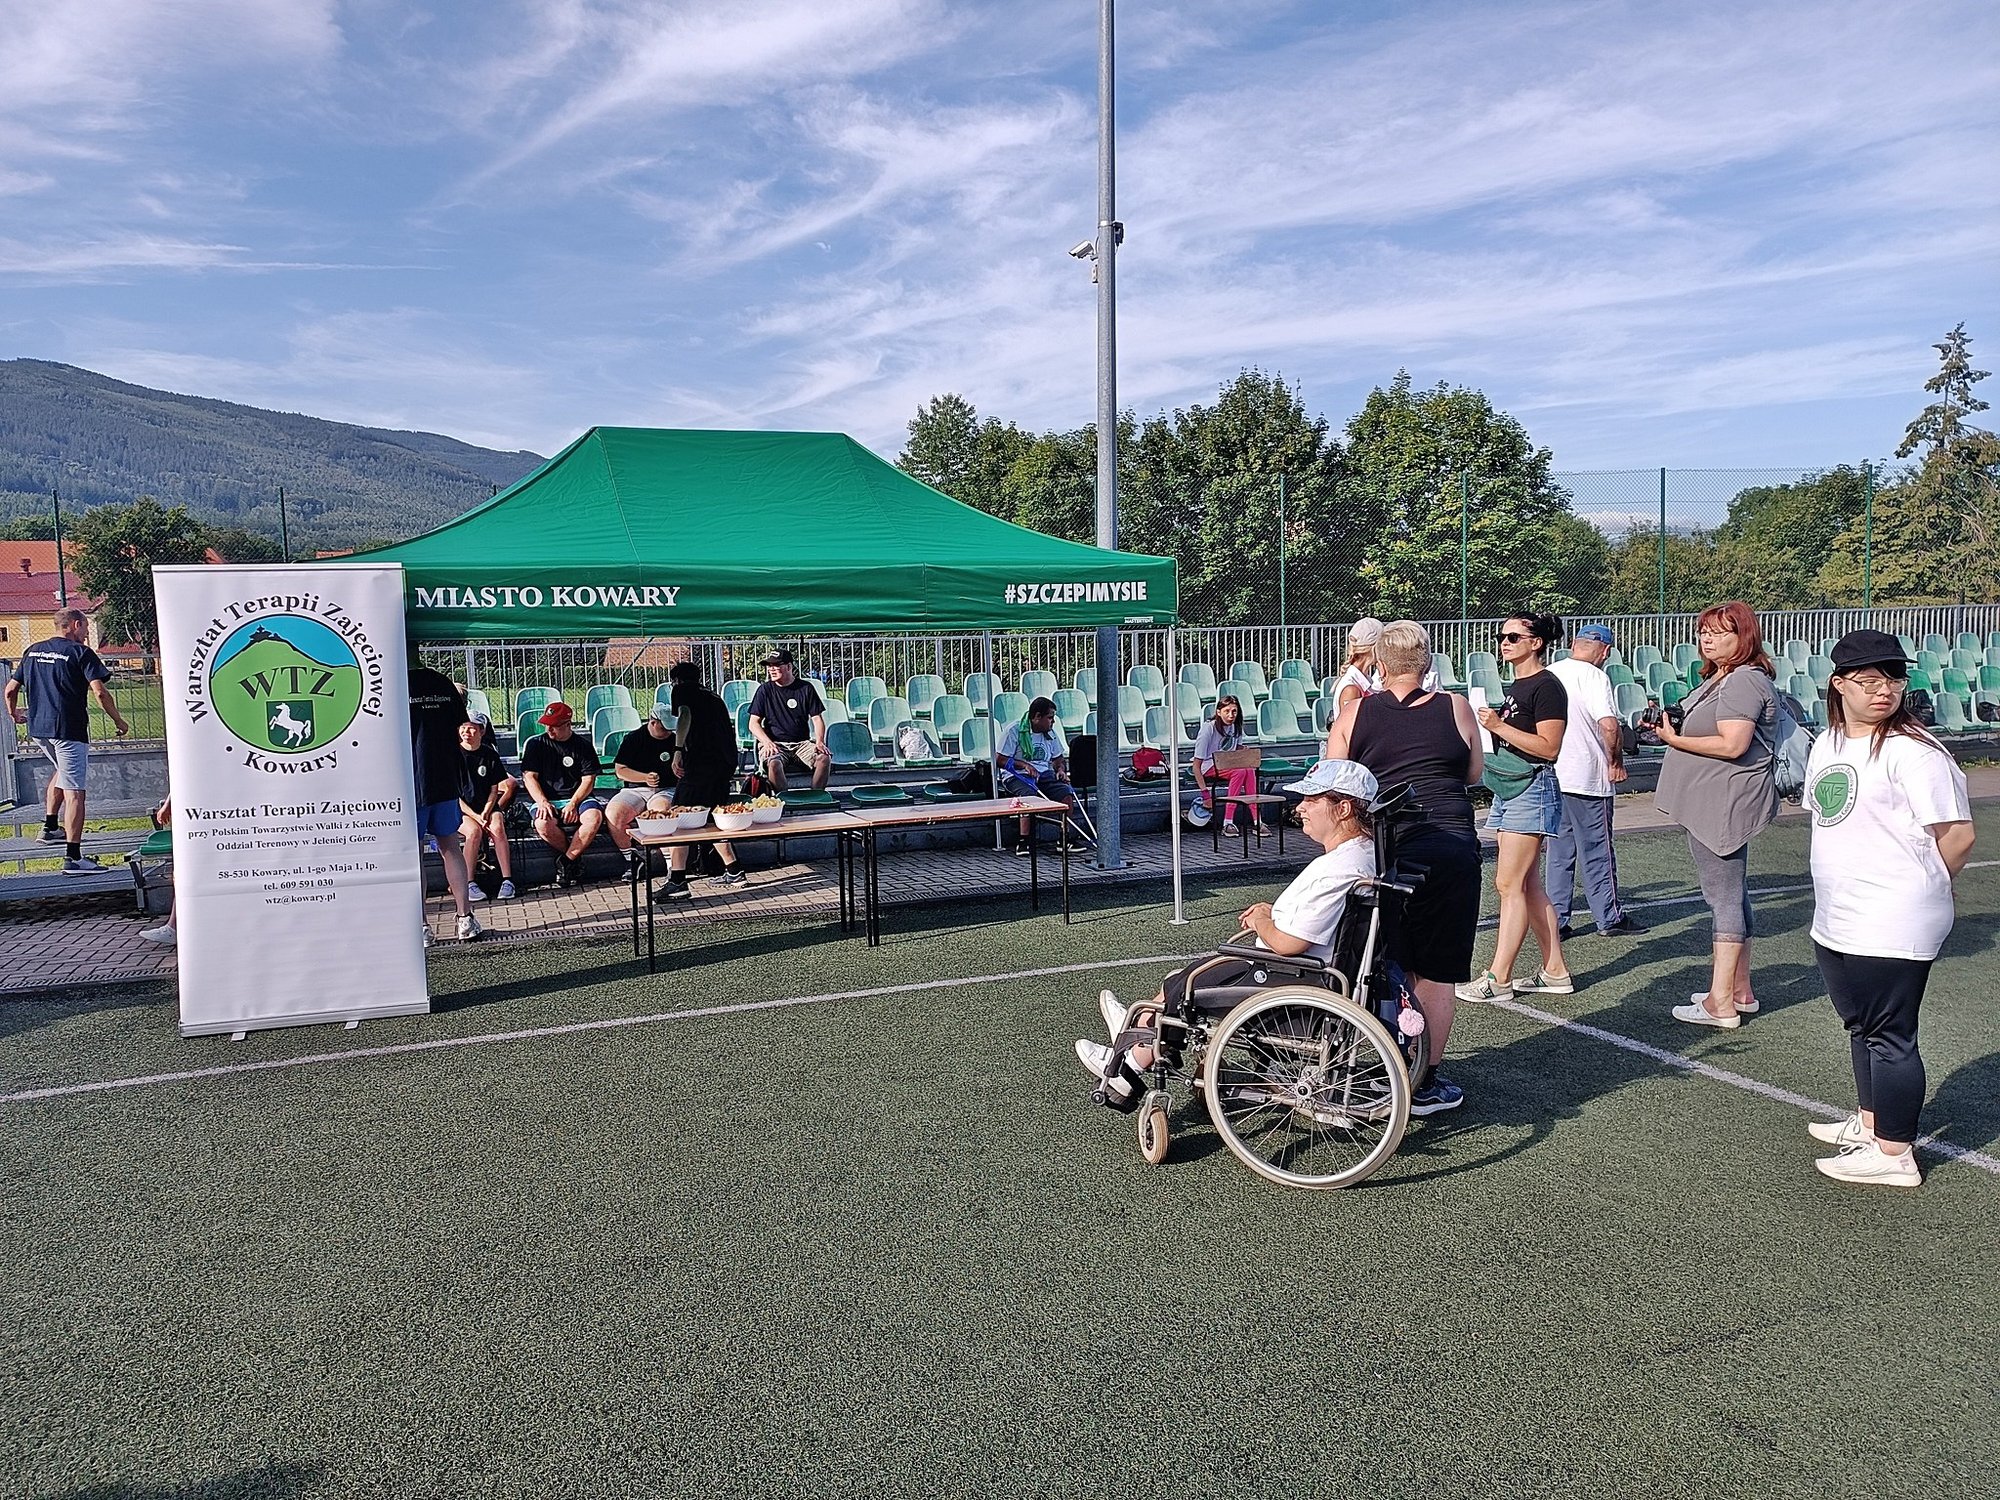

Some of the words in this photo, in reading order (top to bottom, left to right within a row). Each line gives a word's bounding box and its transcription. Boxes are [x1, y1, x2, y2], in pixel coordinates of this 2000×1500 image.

[415, 586, 543, 608] MIASTO
[551, 586, 680, 607] KOWARY
[1005, 582, 1147, 604] #SZCZEPIMYSIE
[185, 618, 228, 724] Warsztat
[224, 593, 319, 621] Terapii
[322, 602, 384, 718] Zajęciowej
[238, 666, 336, 700] WTZ
[243, 750, 338, 774] Kowary
[185, 806, 256, 820] Warsztat
[261, 802, 316, 818] Terapii
[320, 798, 401, 816] Zajęciowej
[188, 830, 209, 839] przy
[212, 827, 249, 837] Polskim
[251, 823, 314, 834] Towarzystwie
[352, 820, 401, 829] Kalectwem
[255, 840, 300, 848] Terenowy
[312, 836, 347, 845] Jeleniej
[349, 834, 377, 843] Górze
[218, 869, 249, 879] 58-530
[252, 869, 291, 877] Kowary,
[293, 866, 305, 874] ul.
[308, 866, 326, 875] 1-go
[329, 864, 353, 873] Maja
[264, 883, 278, 891] tel.
[280, 881, 297, 889] 609
[299, 880, 314, 888] 591
[317, 878, 334, 887] 030
[265, 892, 336, 905] wtz@kowary.pl
